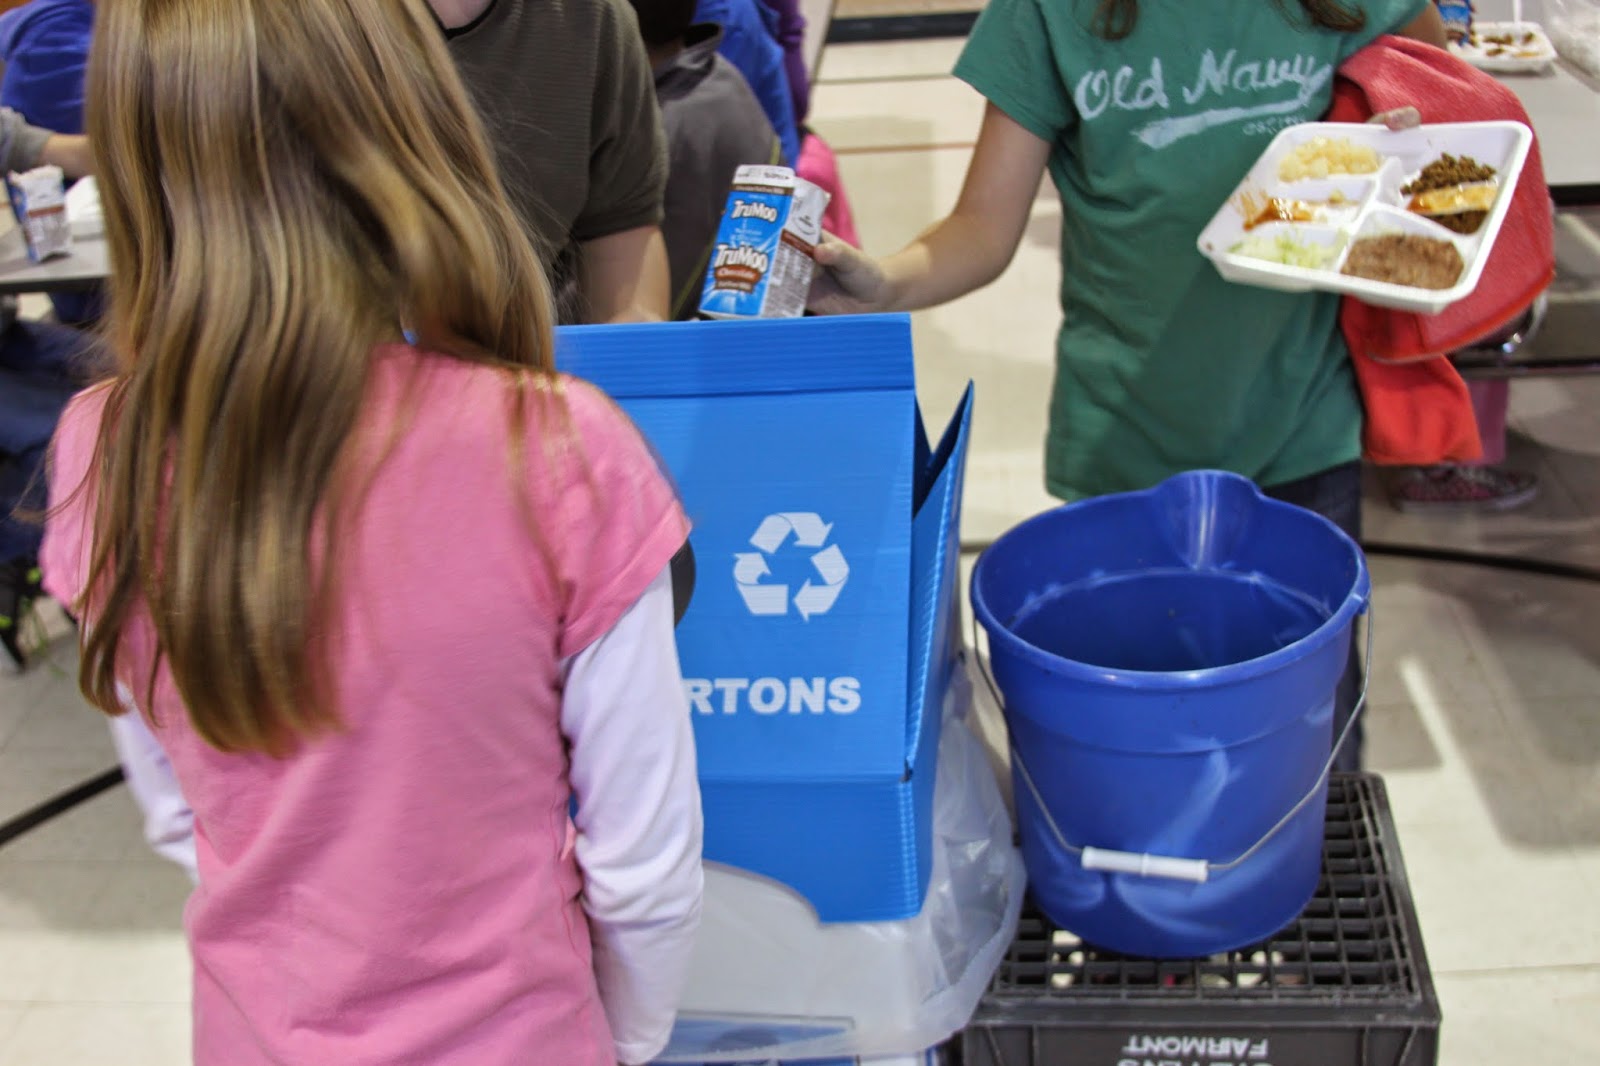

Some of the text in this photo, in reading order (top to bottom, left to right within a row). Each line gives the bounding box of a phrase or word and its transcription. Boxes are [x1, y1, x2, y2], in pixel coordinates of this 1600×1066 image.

[1075, 47, 1333, 121] Old Navy
[731, 200, 778, 222] TruMoo
[713, 244, 769, 273] TruMoo
[682, 676, 862, 715] RTONS
[1121, 1034, 1269, 1057] FAIRMONT
